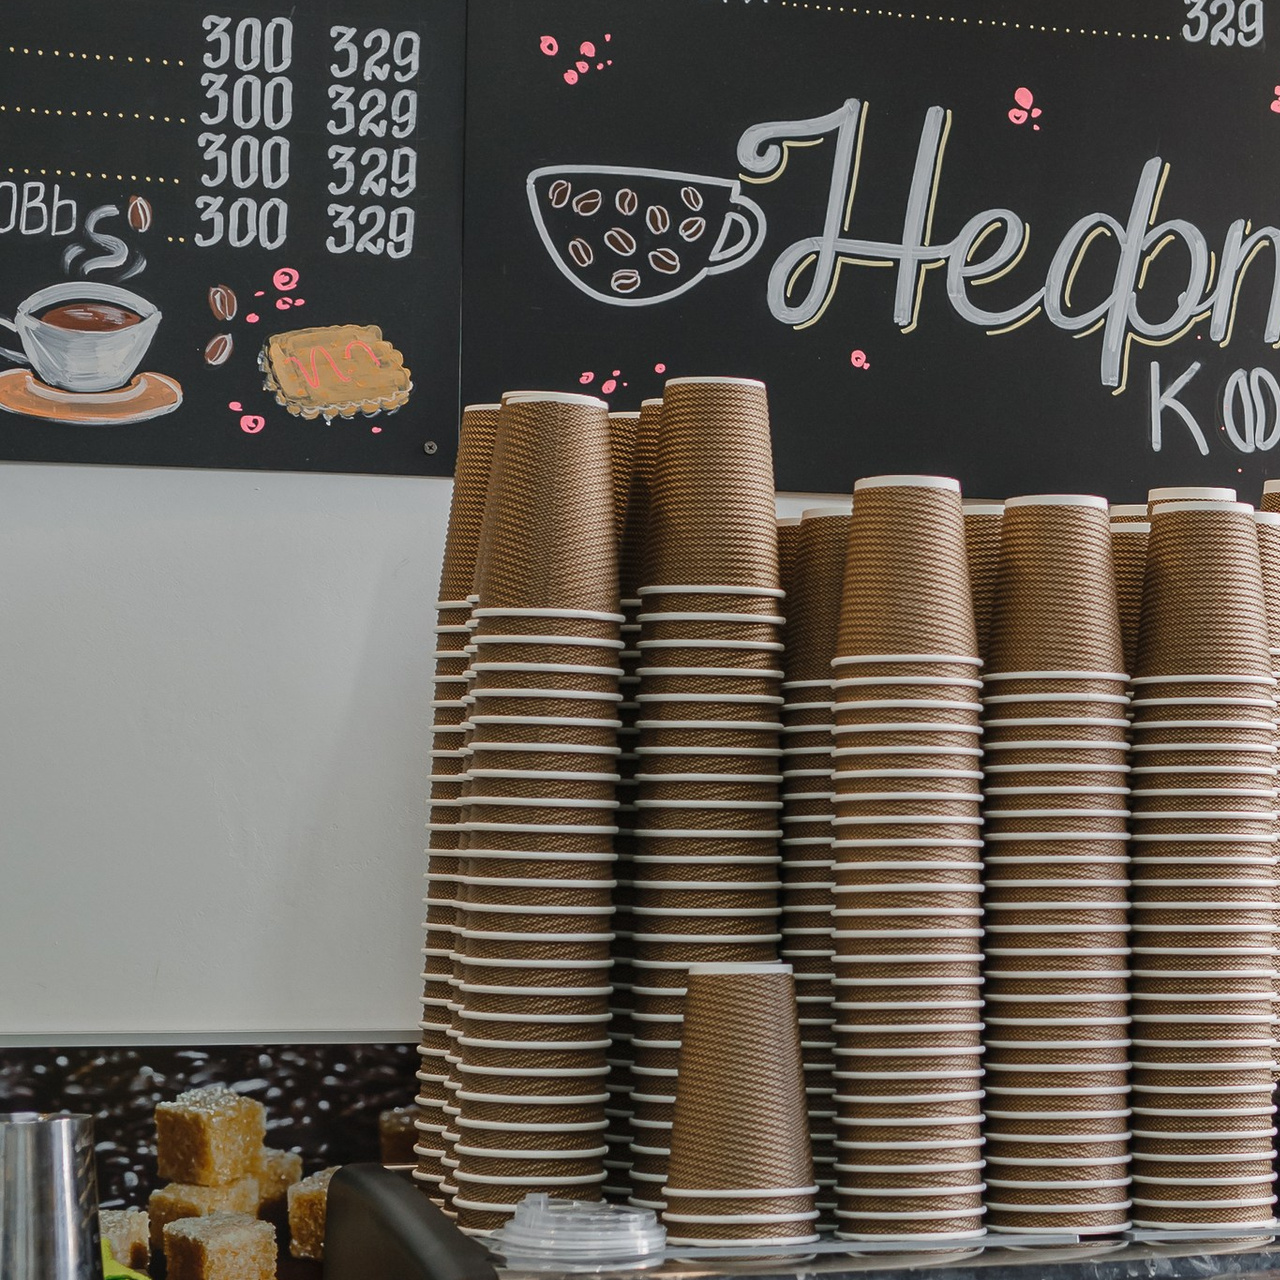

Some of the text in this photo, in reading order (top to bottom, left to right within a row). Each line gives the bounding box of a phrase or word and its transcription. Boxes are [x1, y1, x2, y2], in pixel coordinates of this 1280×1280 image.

[202, 15, 420, 82] 300 329
[200, 74, 418, 138] 300 329
[197, 135, 417, 198] 300 329
[194, 197, 288, 250] 300
[326, 205, 415, 258] 329
